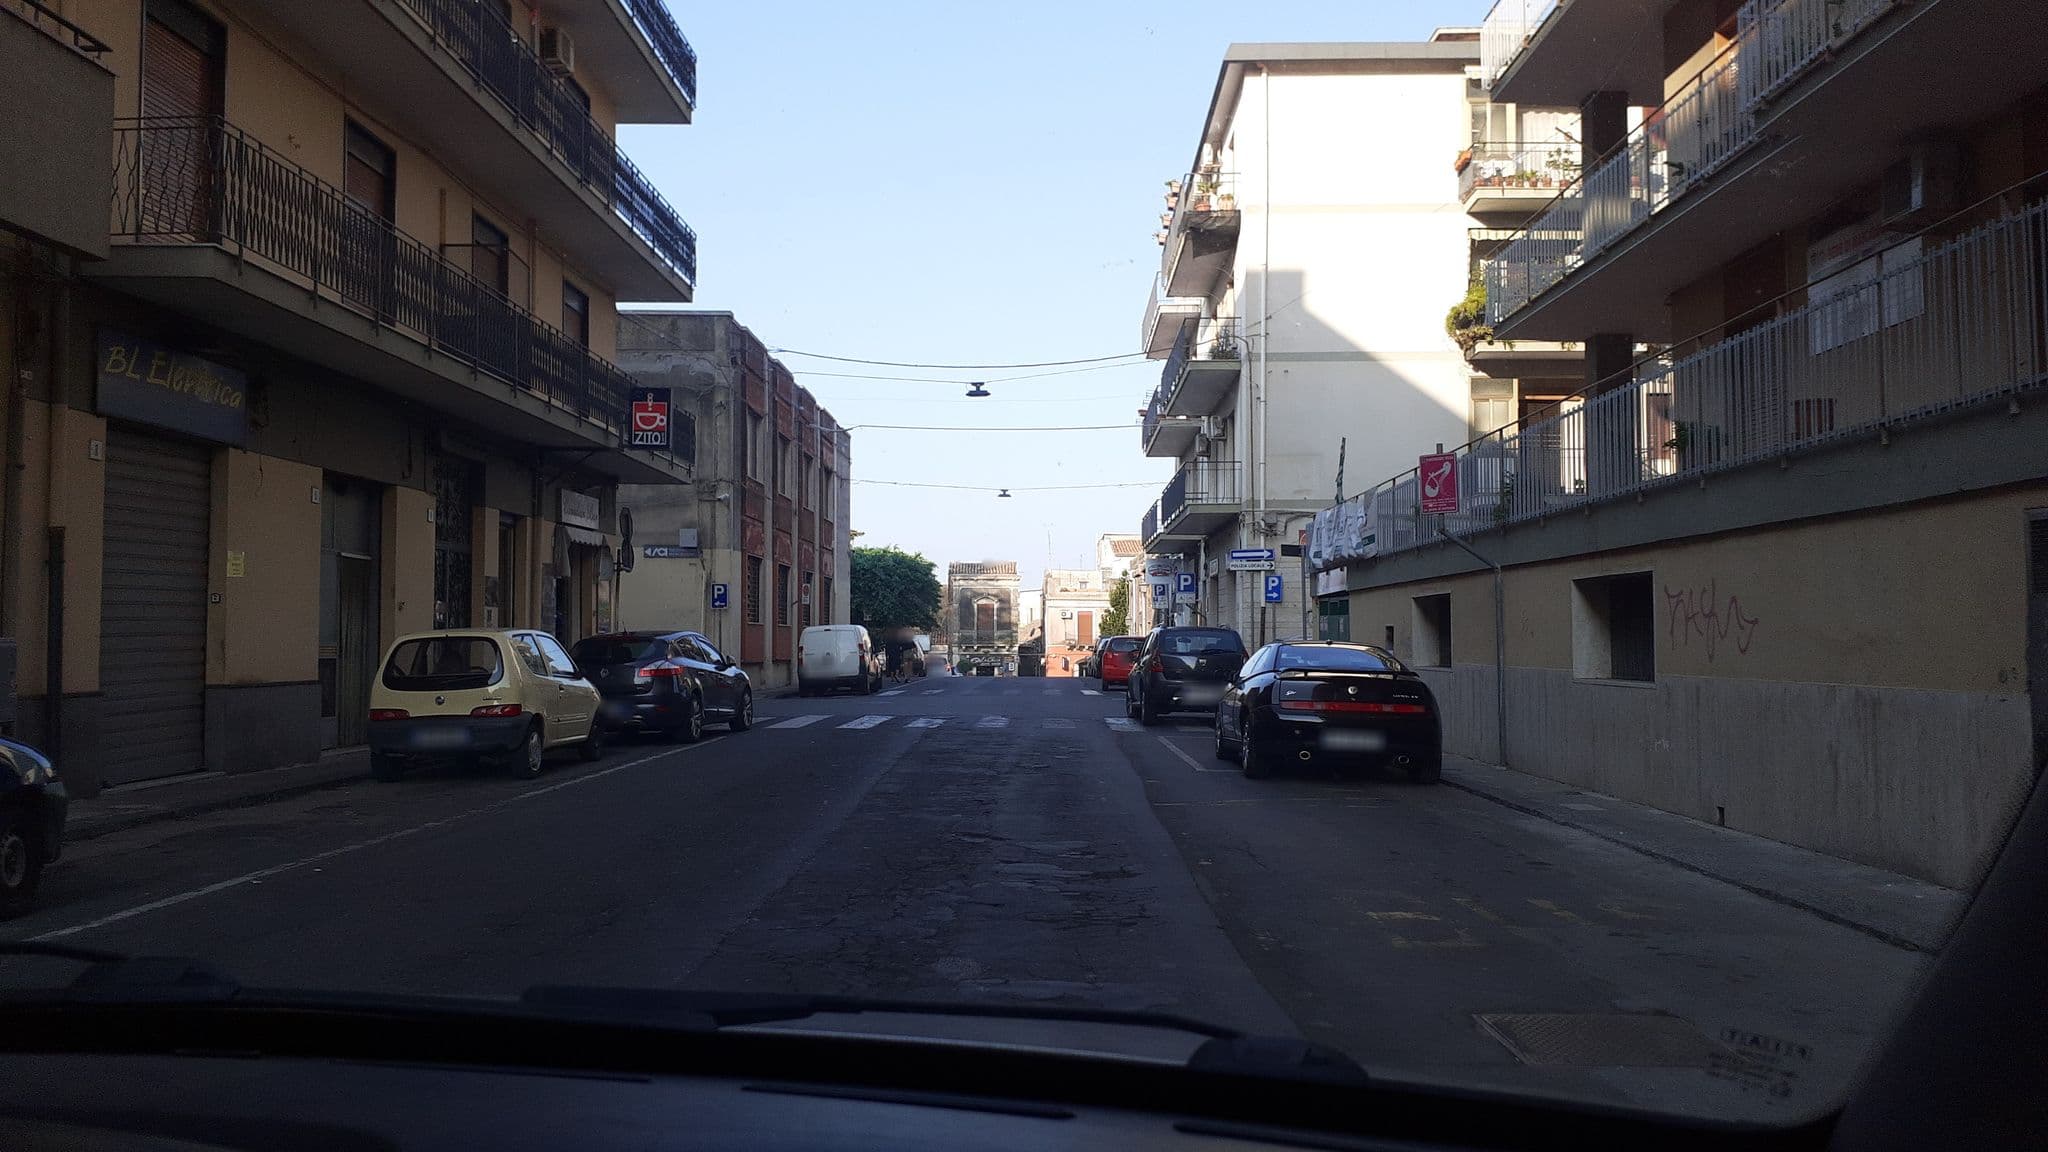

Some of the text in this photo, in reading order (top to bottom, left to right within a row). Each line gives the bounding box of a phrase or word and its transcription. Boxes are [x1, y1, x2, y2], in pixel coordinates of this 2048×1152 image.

[105, 345, 140, 381] BL
[1180, 575, 1192, 591] P
[1268, 577, 1279, 591] P
[714, 585, 725, 599] P
[1155, 585, 1164, 596] P
